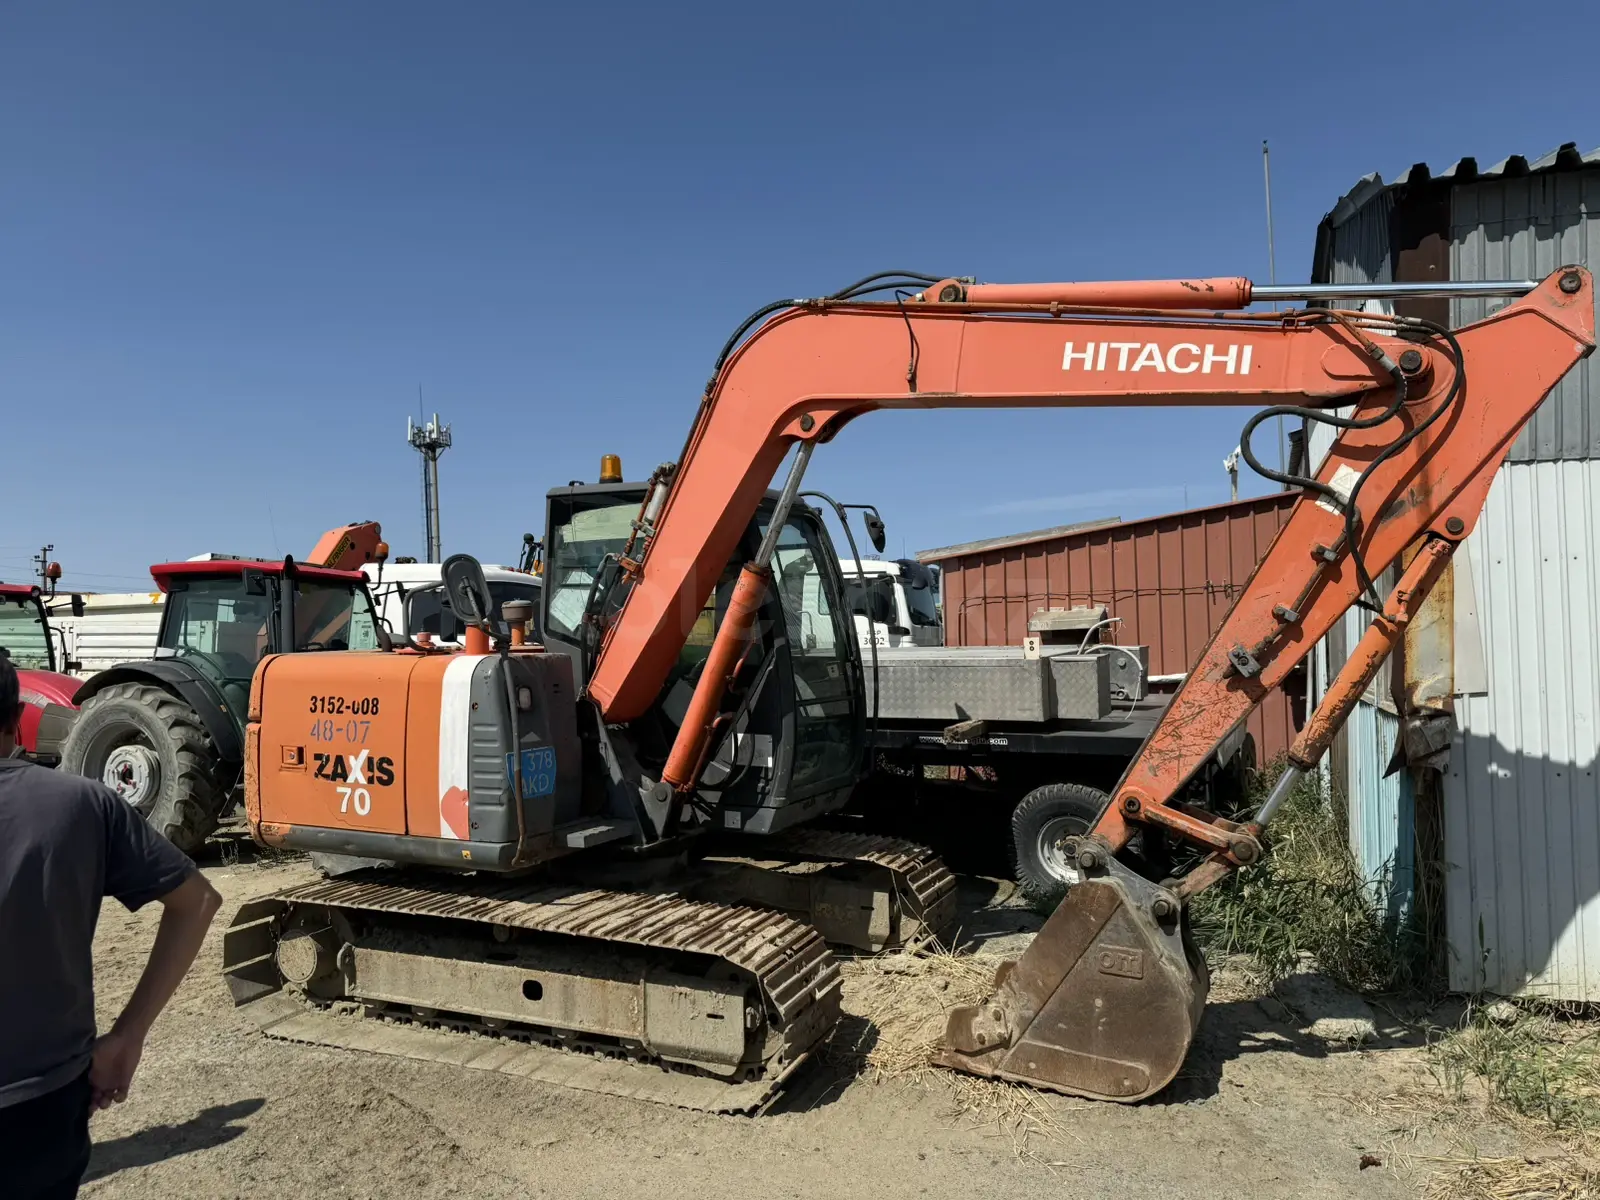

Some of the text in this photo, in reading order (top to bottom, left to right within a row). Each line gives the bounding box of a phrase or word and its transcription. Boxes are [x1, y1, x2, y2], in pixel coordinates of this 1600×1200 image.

[1061, 341, 1253, 375] HITACHI
[327, 536, 351, 568] ALFINGER
[309, 695, 380, 716] 3152-008
[309, 718, 371, 744] 48-07
[313, 748, 395, 787] ZAXIS
[336, 786, 371, 816] 70
